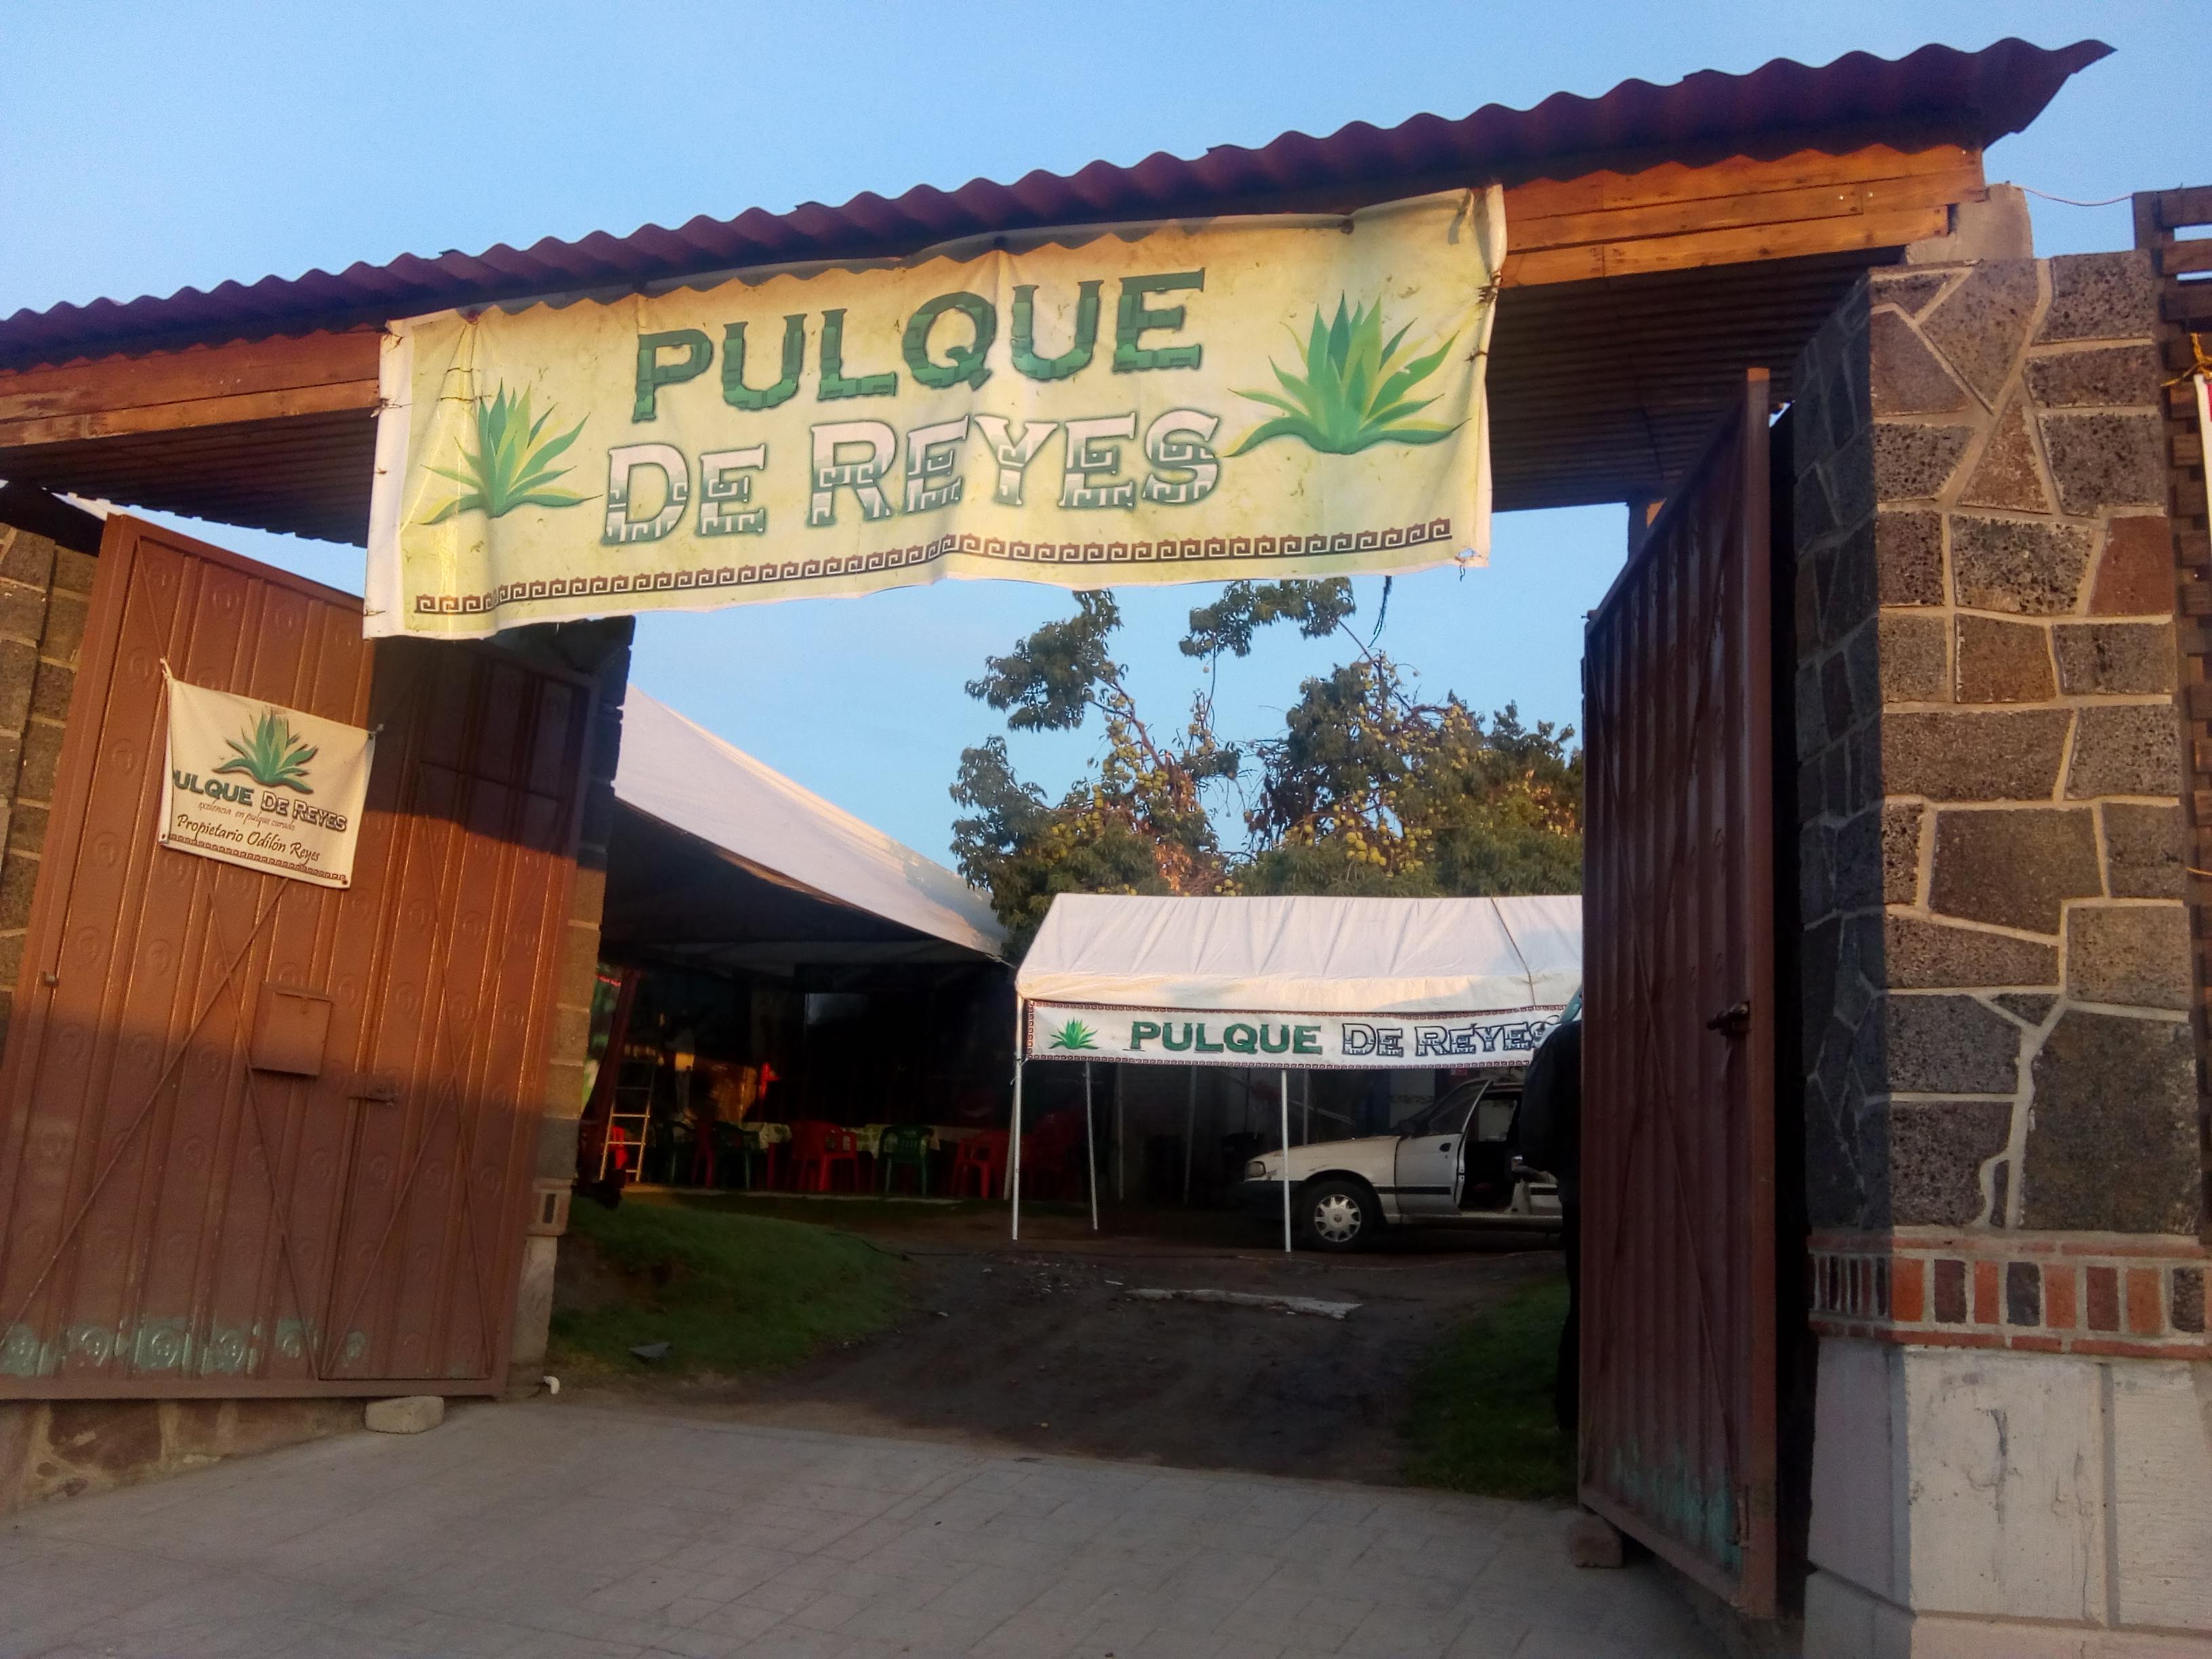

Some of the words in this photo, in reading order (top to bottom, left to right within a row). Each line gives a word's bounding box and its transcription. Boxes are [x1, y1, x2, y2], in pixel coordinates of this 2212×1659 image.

[632, 267, 1206, 423] PULQUE
[600, 443, 767, 546] DE
[805, 408, 1221, 529] REYES
[172, 769, 255, 807] ULQUE
[261, 790, 289, 817] DE
[292, 799, 348, 832] REYES
[177, 814, 243, 842] Propietario
[247, 831, 286, 853] Odilón
[289, 842, 321, 866] Reyes
[1130, 1021, 1323, 1054] PULQUE
[1342, 1023, 1404, 1058] DE
